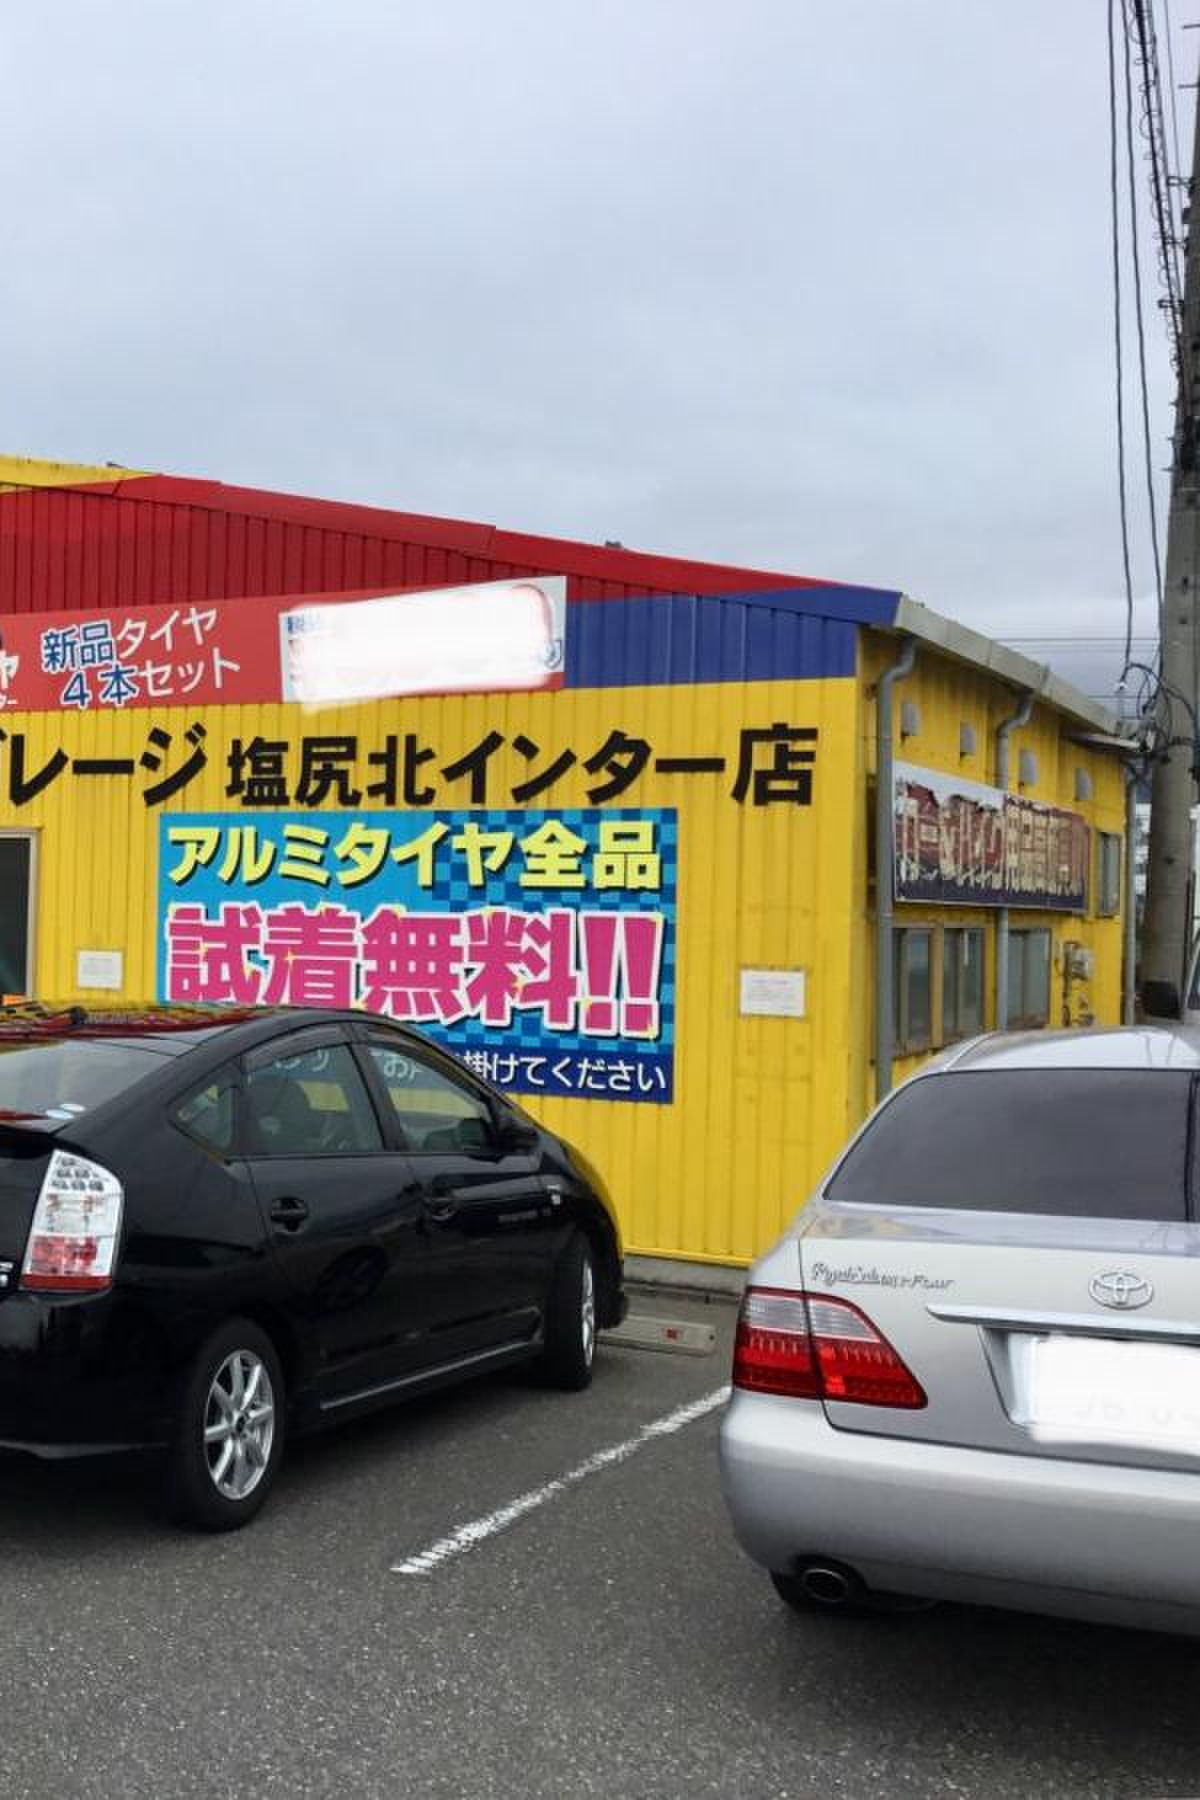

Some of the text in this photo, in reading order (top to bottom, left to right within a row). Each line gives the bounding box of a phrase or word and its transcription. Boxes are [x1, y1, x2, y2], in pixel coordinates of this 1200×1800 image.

[40, 606, 217, 673] 新品タイヤ
[225, 723, 818, 806] 塩尻北インター店
[167, 819, 661, 889] アルミタイヤ全品
[166, 901, 664, 1038] 試着無料!!
